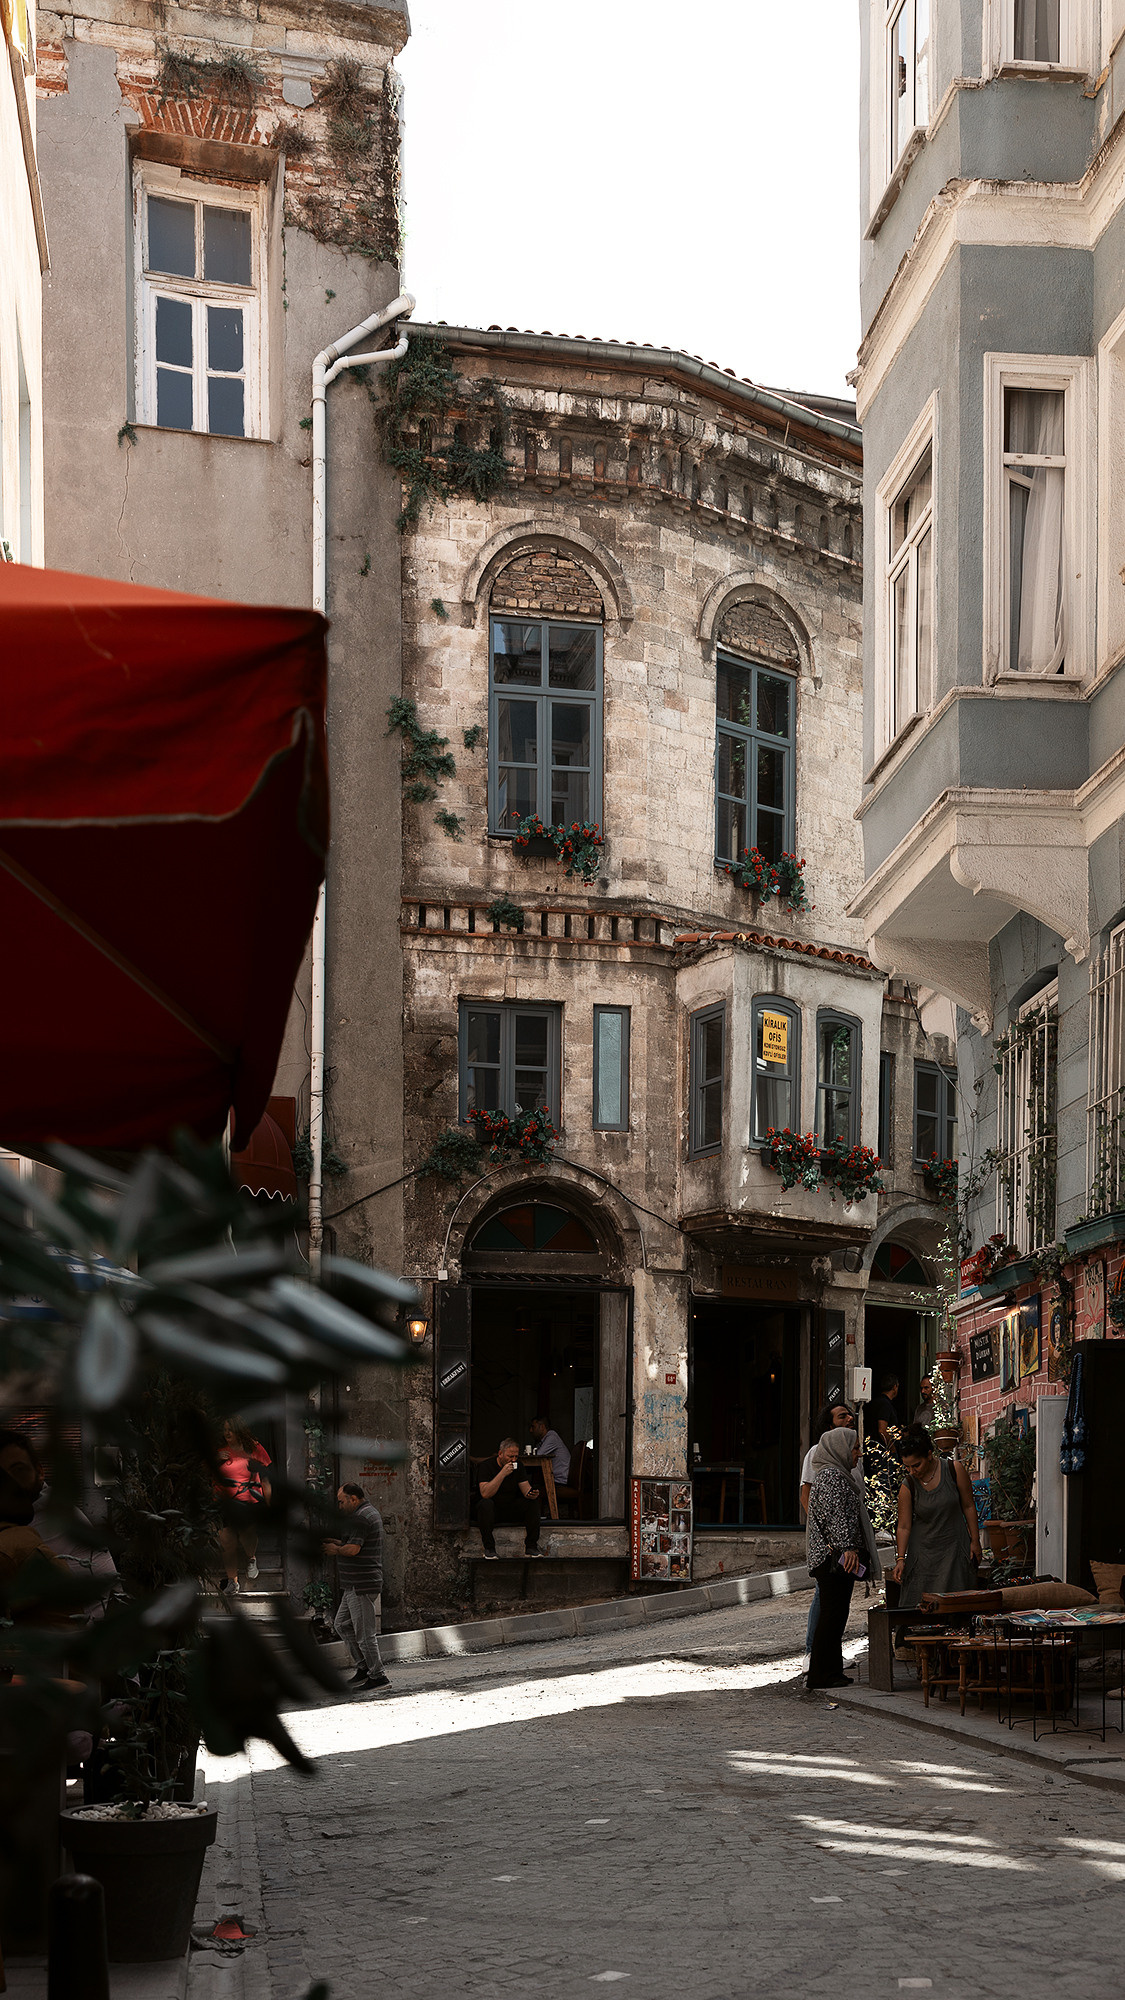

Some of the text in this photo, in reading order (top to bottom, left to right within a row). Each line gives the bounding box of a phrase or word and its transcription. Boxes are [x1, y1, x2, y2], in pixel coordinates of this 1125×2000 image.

[764, 1017, 787, 1031] KİRALIK
[768, 1031, 782, 1043] OFİS
[727, 1276, 793, 1289] RESTAURANT
[441, 1364, 465, 1386] BREAKFAST
[442, 1443, 464, 1463] BURGER
